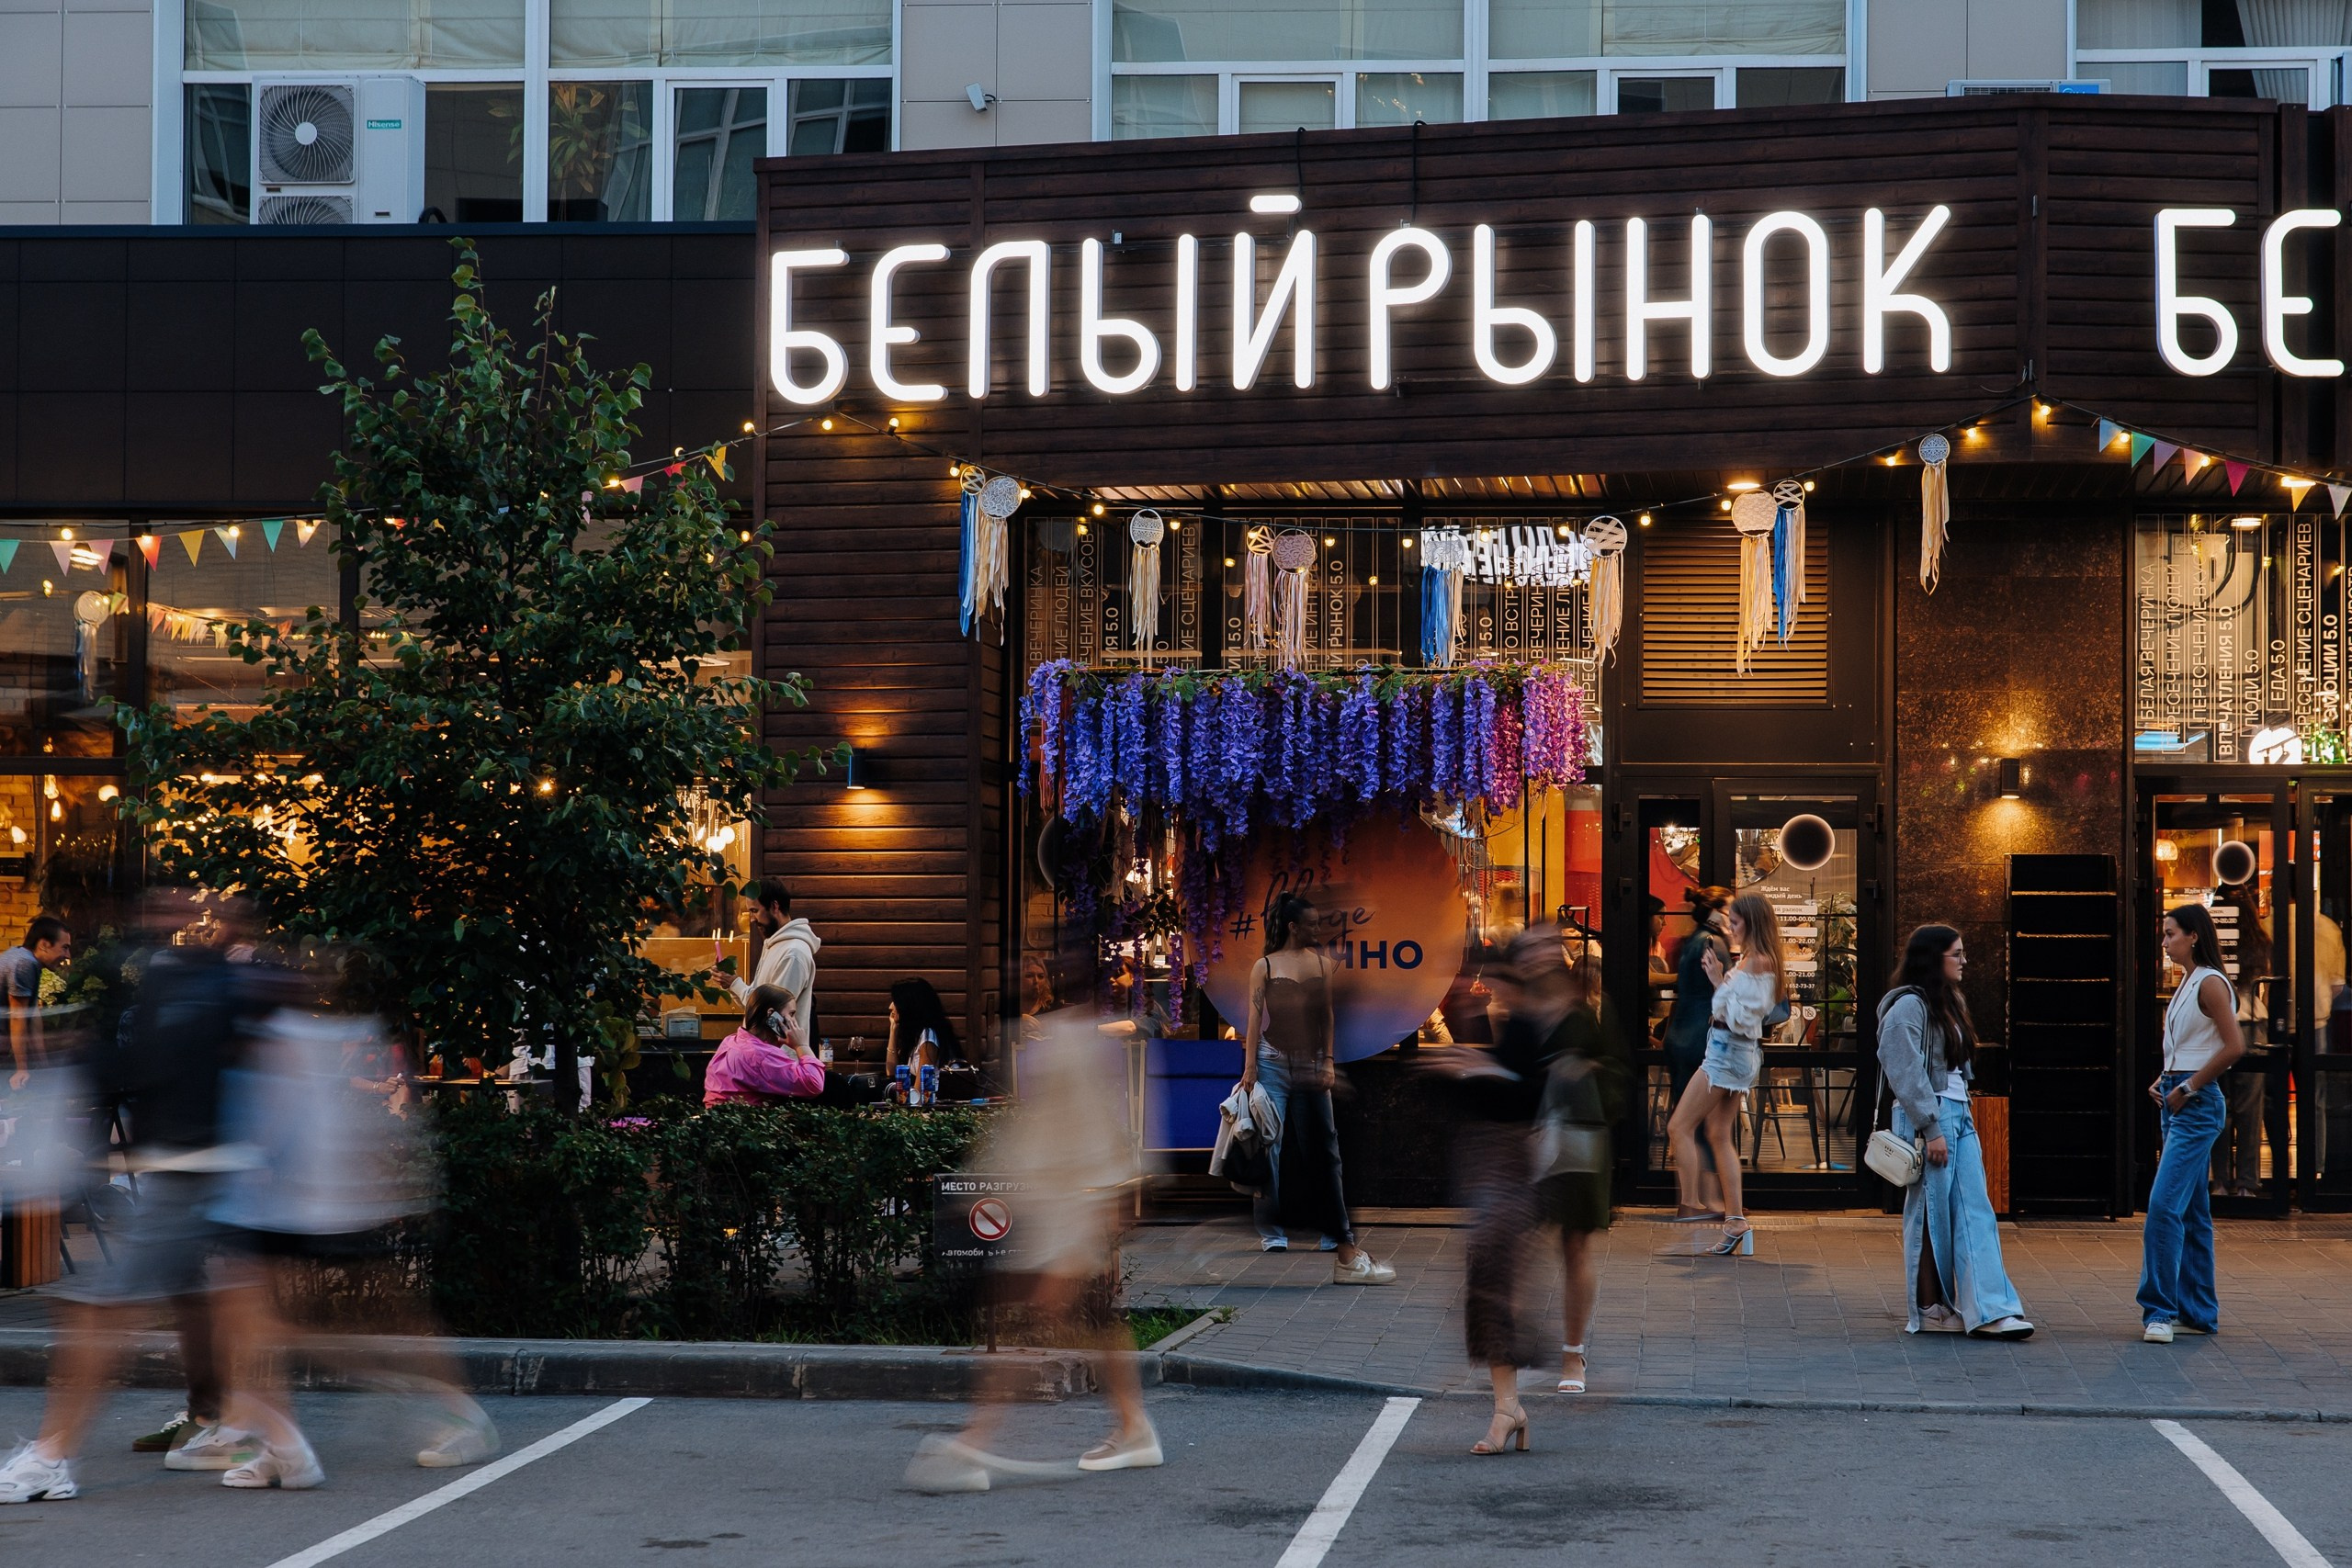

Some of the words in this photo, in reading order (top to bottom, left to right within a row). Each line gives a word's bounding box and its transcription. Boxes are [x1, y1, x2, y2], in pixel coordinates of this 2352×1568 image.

[771, 194, 1316, 405] БЕЛЫЙ
[1369, 205, 1952, 391] РЫНОК
[1080, 532, 1094, 597] ВКУСОВ
[1181, 526, 1197, 626] СЦЕНАРИЕВ
[1329, 560, 1343, 585] 5.0
[1554, 543, 1570, 604] ЛЮДЕЙ
[2192, 530, 2207, 597] ВКУСОВ
[2297, 523, 2313, 625] СЦЕНАРИЕВ
[1029, 566, 1044, 660] ВЕЧЕРИНКА
[1052, 566, 1070, 626] ЛЮДЕЙ
[1105, 607, 1119, 631] 5.0
[1329, 589, 1343, 648] РЫНОК
[1531, 562, 1544, 660] ВЕЧЕРИНКА
[2141, 564, 2154, 661] ВЕЧЕРИНКА
[2164, 564, 2183, 625] ЛЮДЕЙ
[2218, 605, 2233, 631] 5.0
[1227, 617, 1241, 641] 5.0
[1479, 616, 1493, 641] 5.0
[2270, 639, 2286, 664] 5.0
[2323, 615, 2338, 640] 5.0
[2192, 601, 2207, 721] ПЕРЕСЕЧЕНИЕ
[2245, 649, 2259, 673] 5.0
[2270, 667, 2288, 701] ЕДА
[2323, 643, 2340, 718] ЭМОЦИИ
[2141, 665, 2154, 720] БЕЛАЯ
[2218, 635, 2233, 754] ВПЕЧАТЛЕНИЯ
[2245, 677, 2261, 729] ЛЮДИ
[941, 1181, 977, 1191] МЕСТО
